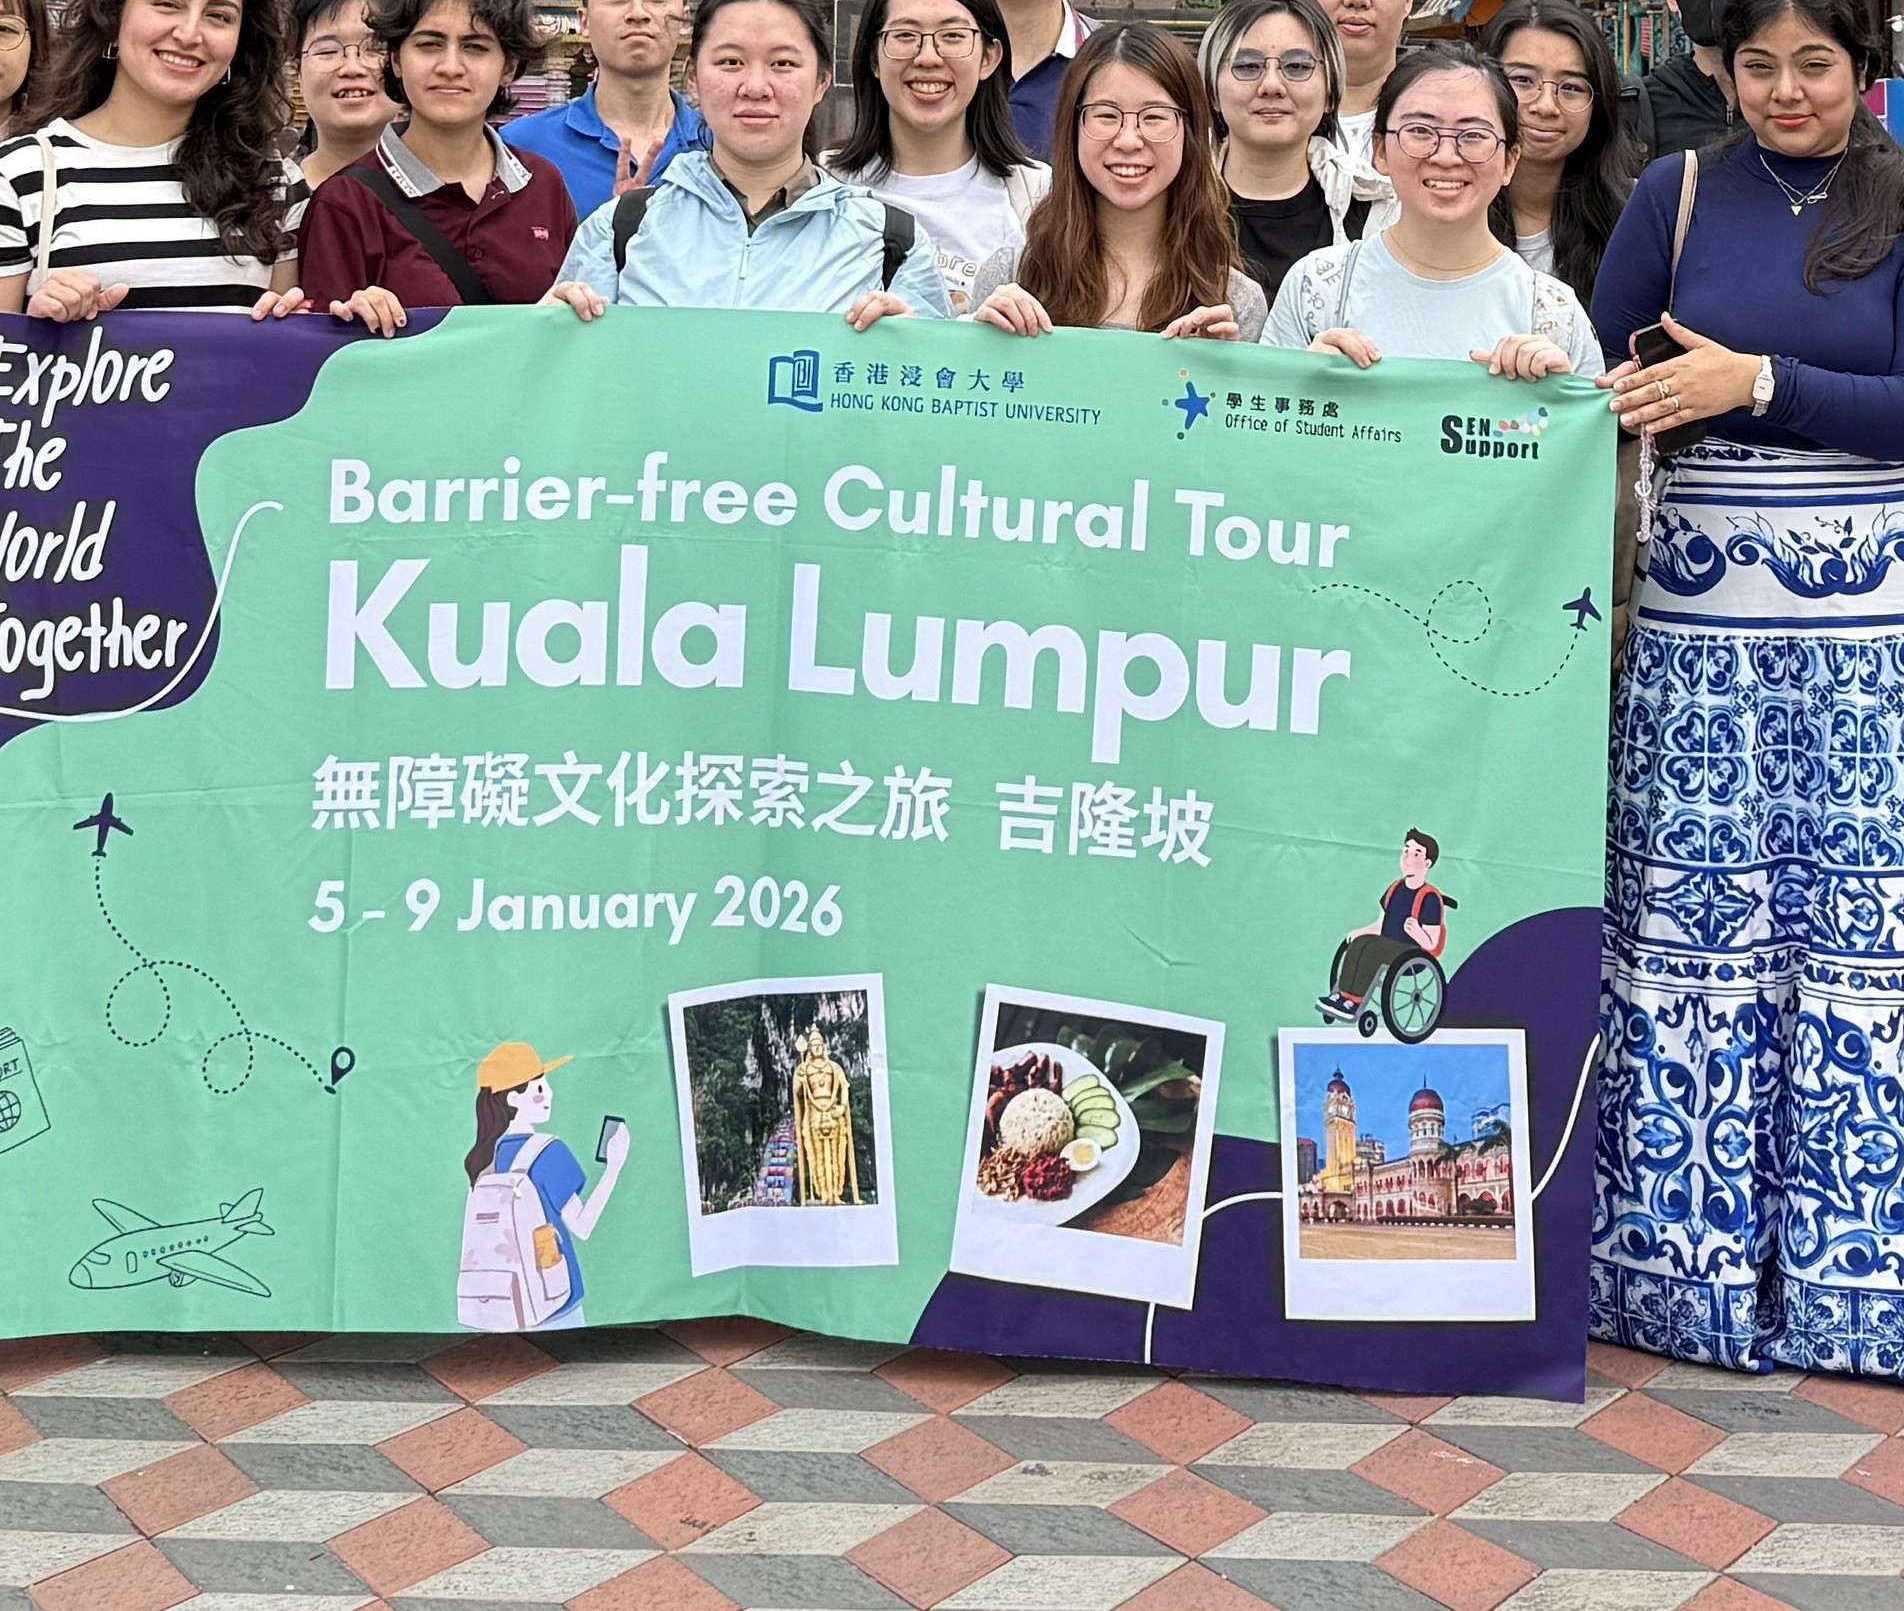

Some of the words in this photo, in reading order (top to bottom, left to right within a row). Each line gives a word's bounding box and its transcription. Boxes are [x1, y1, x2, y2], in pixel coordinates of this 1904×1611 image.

[832, 361, 1025, 393] 香港浸會大學
[830, 393, 874, 411] HONG
[881, 395, 924, 414] KONG
[931, 399, 999, 418] BAPTIST
[1005, 403, 1101, 425] UNIVERSITY
[1225, 392, 1340, 418] 學生事務處
[1225, 413, 1268, 432] Office
[1274, 418, 1289, 433] of
[1296, 420, 1345, 439] Student
[1351, 426, 1402, 443] Affairs
[329, 452, 798, 526] Barrier-free
[824, 465, 1149, 551] Cultural
[1174, 489, 1350, 568] Tour
[325, 544, 747, 690] Kuala
[788, 563, 1351, 765] Lumpur
[311, 750, 953, 842] 無障礙文化探索之旅
[993, 772, 1214, 868] 吉隆坡
[308, 880, 345, 933] 5
[405, 878, 441, 931] 9
[457, 878, 697, 945] January
[711, 875, 843, 936] 2026
